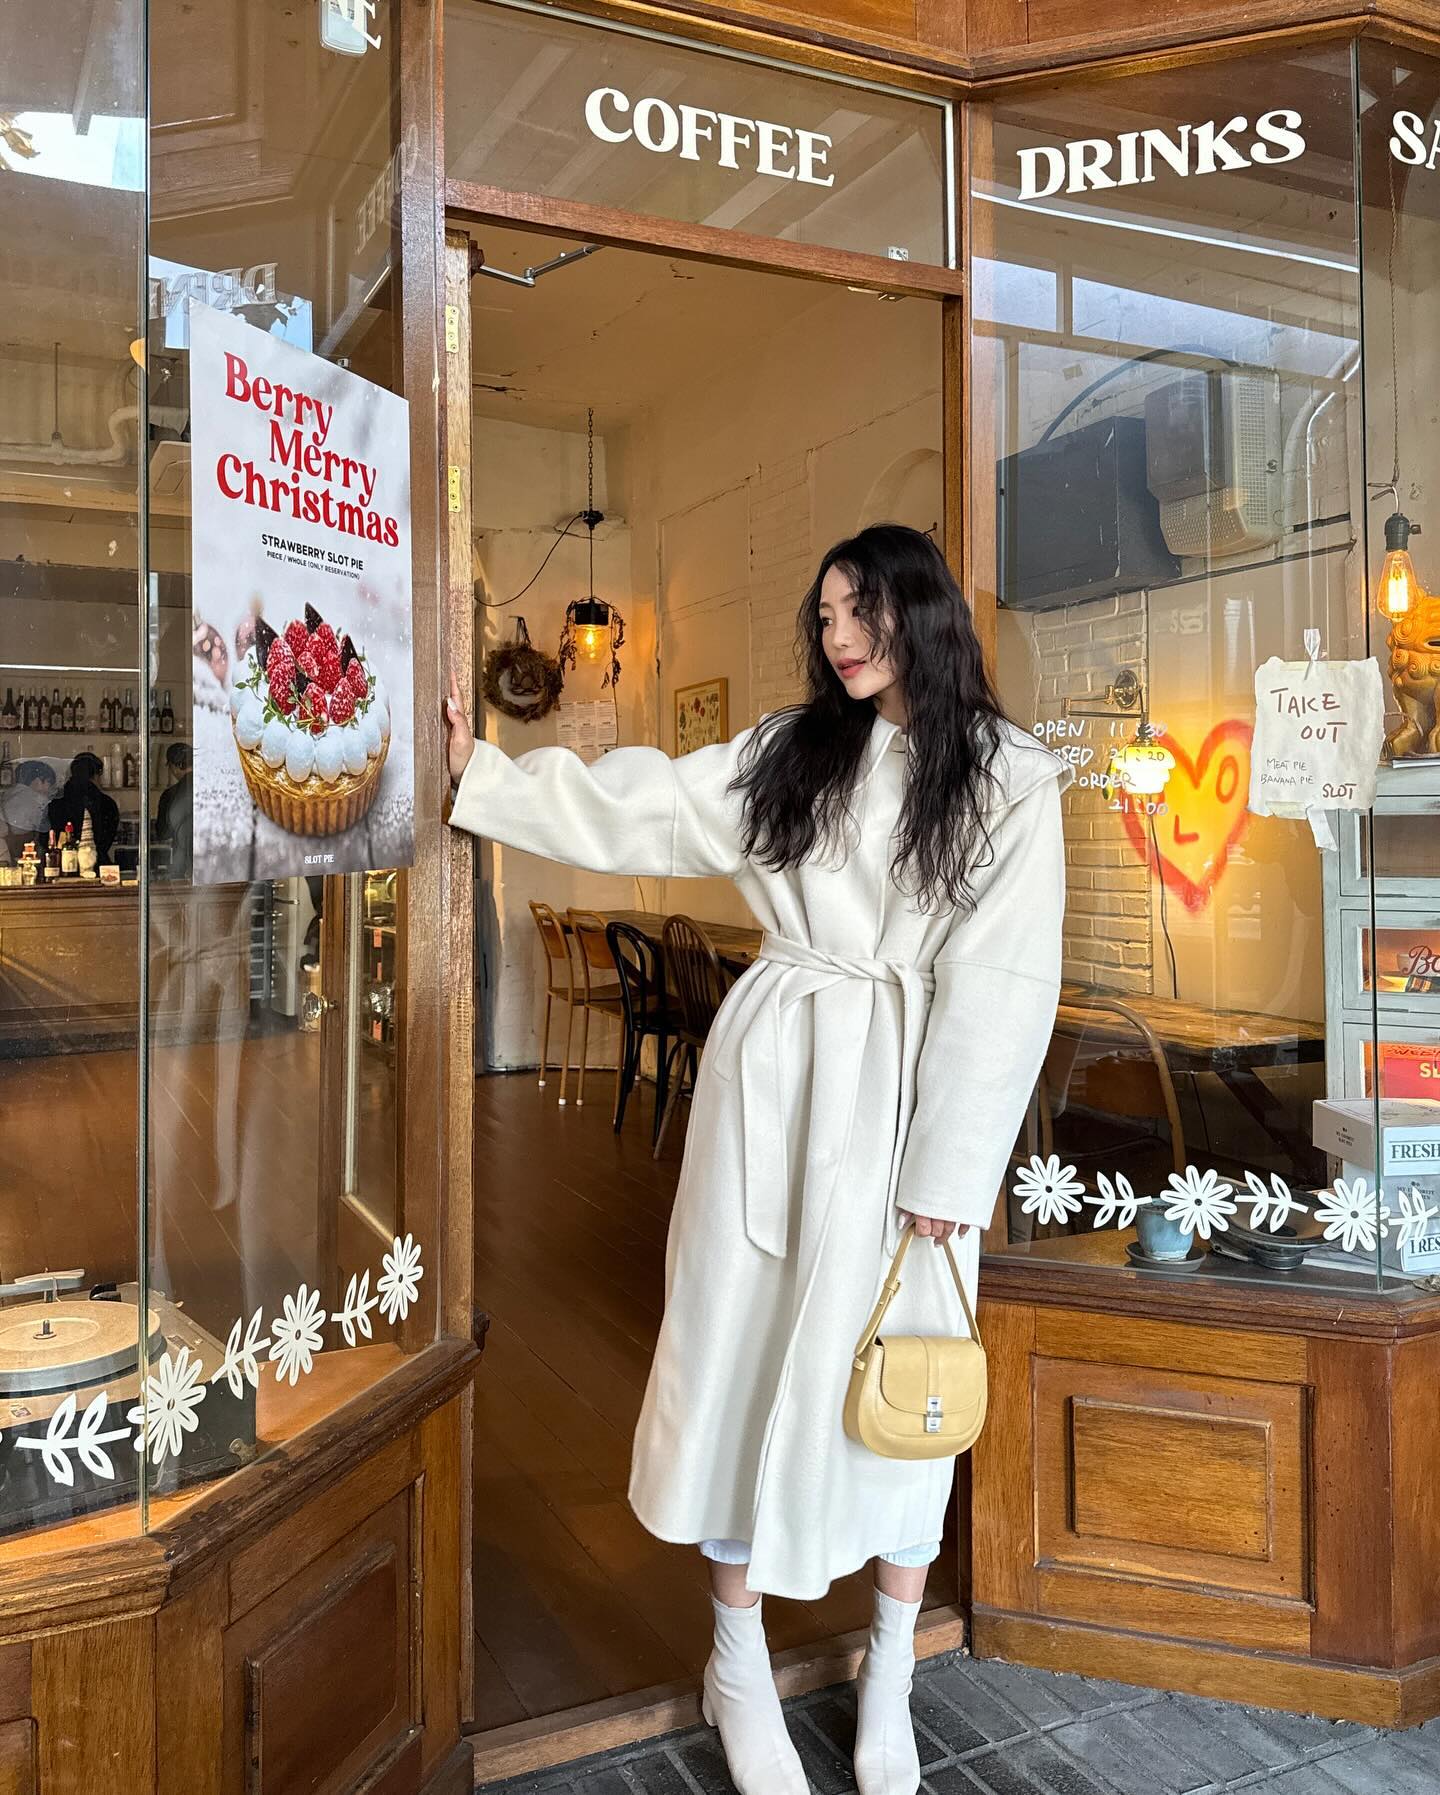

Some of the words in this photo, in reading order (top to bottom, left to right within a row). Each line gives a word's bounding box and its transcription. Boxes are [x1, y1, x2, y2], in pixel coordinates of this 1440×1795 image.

[584, 87, 835, 188] COFFEE
[1016, 109, 1306, 201] DRINKS
[223, 351, 333, 447] Berry
[269, 419, 377, 508] Merry
[216, 453, 399, 548] Christmas
[261, 533, 326, 560] STRAWBERRY
[327, 551, 349, 567] SLOT
[350, 558, 364, 571] PIE
[266, 550, 283, 561] PIECE
[287, 556, 307, 567] WHOLE
[1269, 687, 1341, 718] TAKE
[1032, 719, 1086, 743] OPEN
[1300, 721, 1348, 743] OUT
[1266, 758, 1290, 771] MEAT
[1293, 760, 1308, 771] PIE
[1260, 773, 1297, 785] BANANA
[1300, 775, 1315, 785] PIE
[1322, 783, 1357, 800] SLOT
[304, 854, 322, 865] SLOT
[323, 854, 335, 863] PIE
